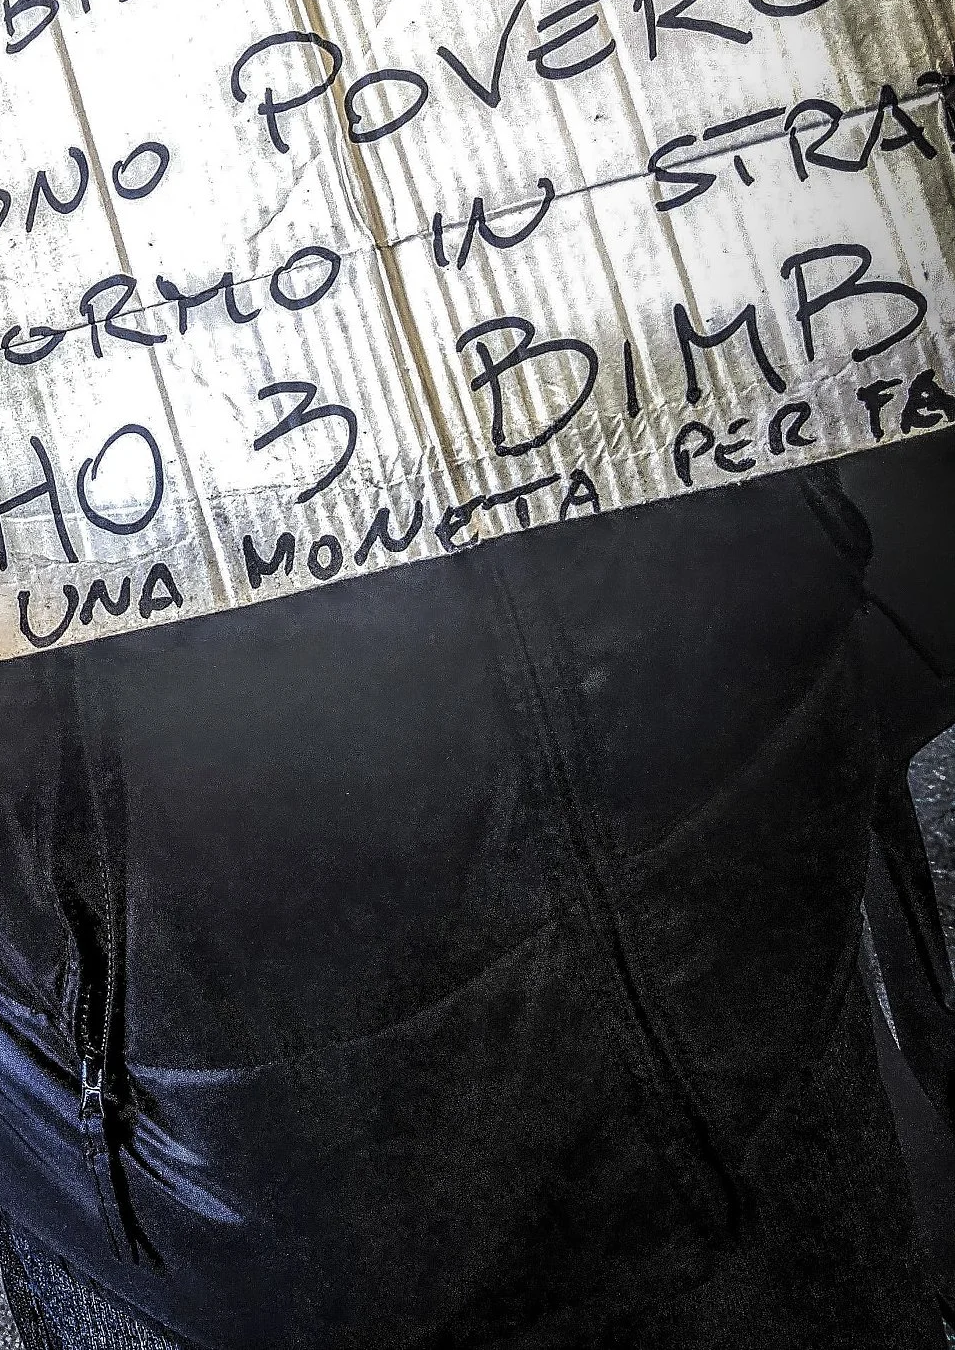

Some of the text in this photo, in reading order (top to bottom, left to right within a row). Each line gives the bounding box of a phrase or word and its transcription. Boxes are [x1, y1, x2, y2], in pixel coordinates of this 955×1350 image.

[431, 177, 556, 270] IN
[252, 381, 357, 504] 3
[455, 243, 927, 458] BIMB
[18, 562, 183, 648] UNA
[243, 469, 600, 589] MONETA
[673, 401, 817, 487] PER
